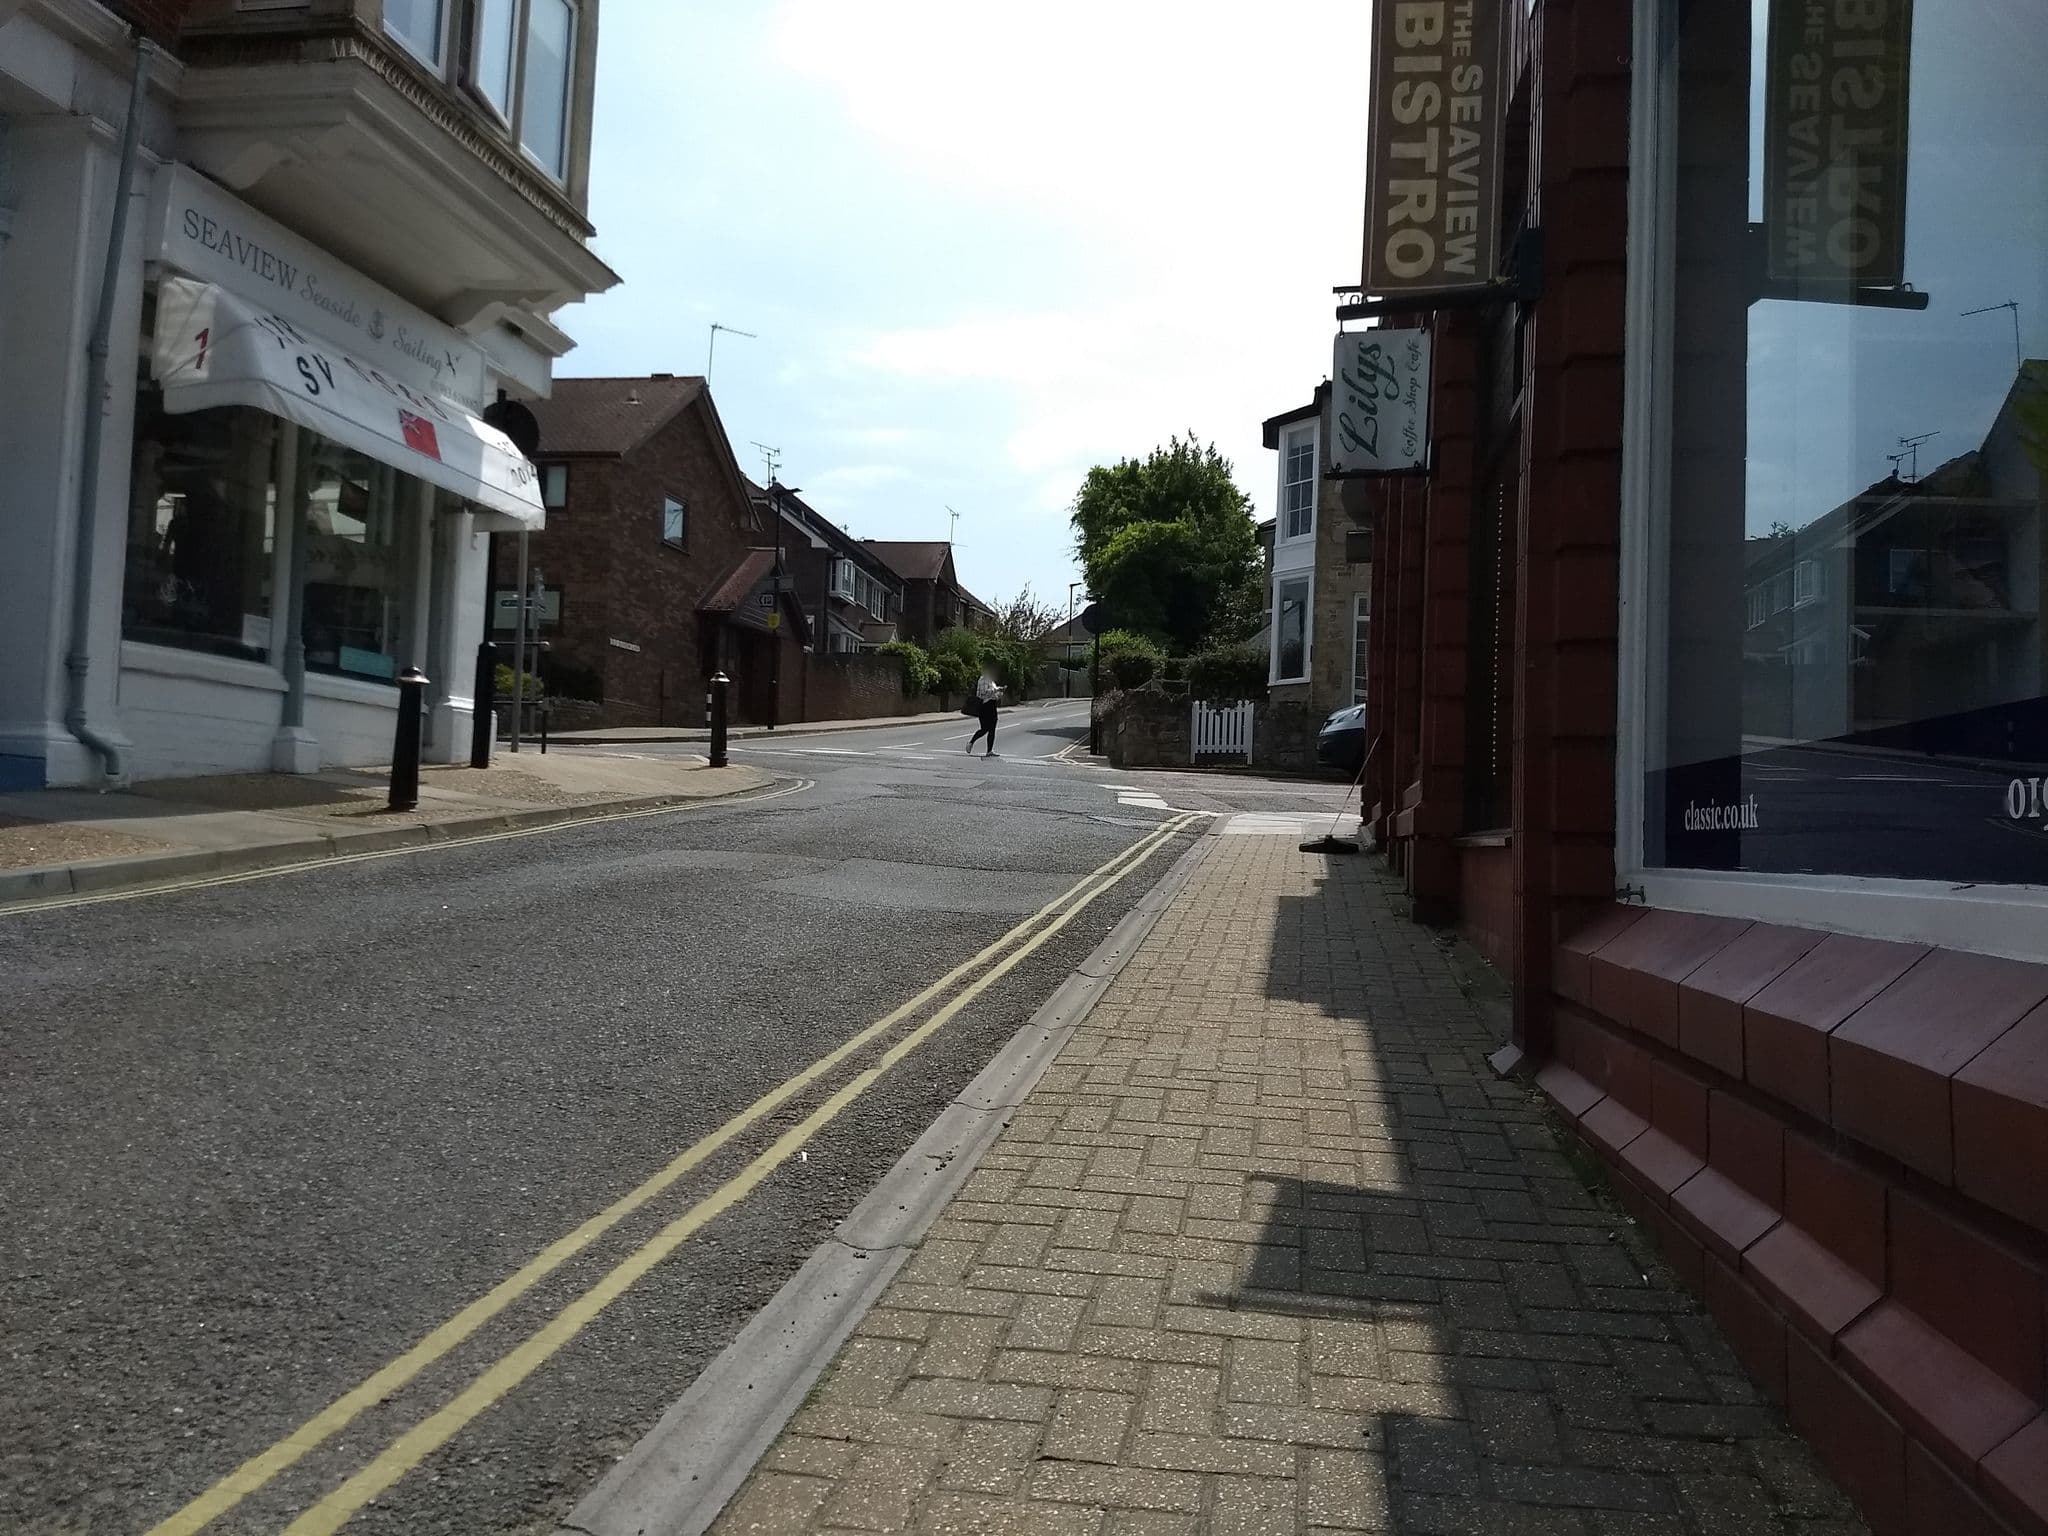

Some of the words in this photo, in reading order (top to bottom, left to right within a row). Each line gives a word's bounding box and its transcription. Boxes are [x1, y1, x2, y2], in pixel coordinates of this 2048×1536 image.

[1452, 0, 1473, 57] THE
[1385, 1, 1444, 279] BISTRO
[1444, 65, 1483, 274] SEAVIEW
[184, 208, 297, 290] SEAVIEW
[301, 275, 360, 327] Seaside
[393, 328, 442, 379] Sailing
[296, 353, 335, 396] SV
[1339, 341, 1400, 458] Lilys
[1684, 793, 1759, 832] classic.co.uk
